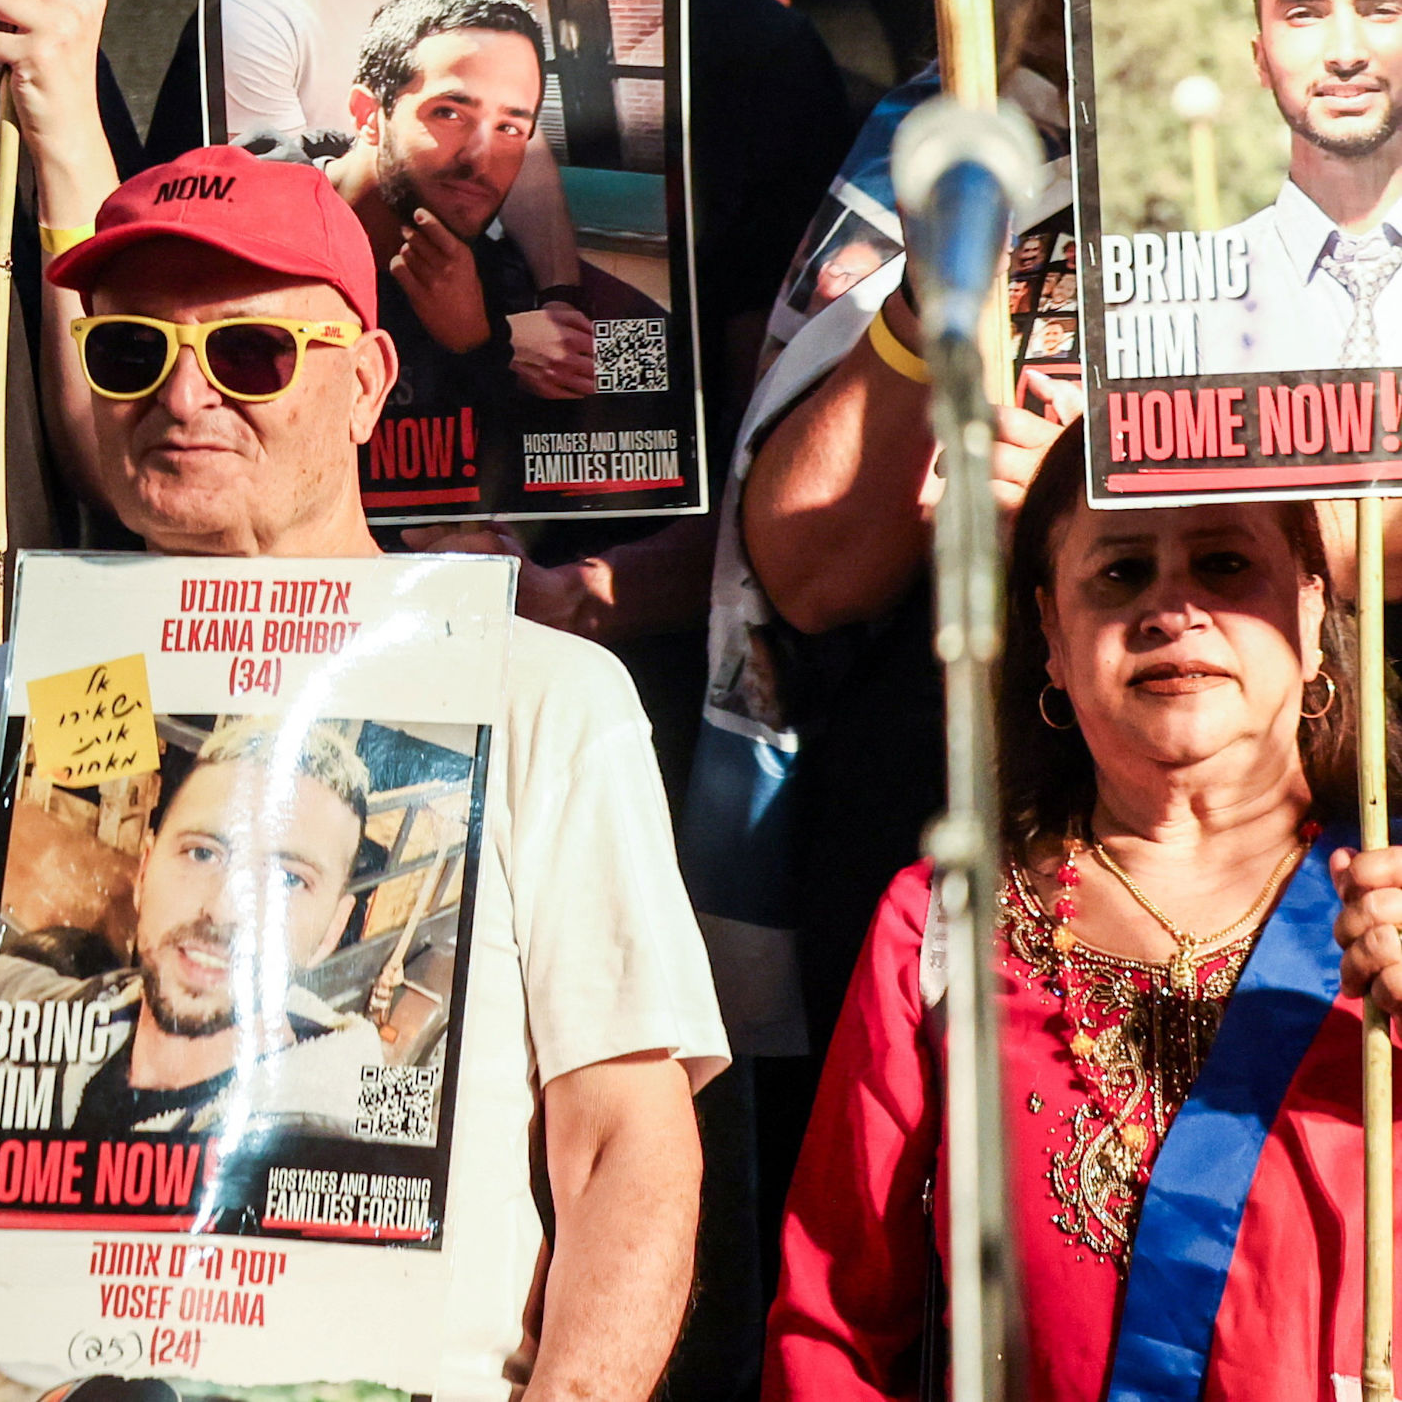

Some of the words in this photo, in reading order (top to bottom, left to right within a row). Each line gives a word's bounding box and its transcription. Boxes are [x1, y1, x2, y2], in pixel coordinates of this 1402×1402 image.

[1101, 230, 1249, 304] BRING
[1104, 308, 1200, 380] HIM
[1108, 387, 1246, 463] HOME
[1258, 371, 1402, 457] NOW!
[370, 406, 478, 480] NOW!
[523, 432, 587, 455] HOSTAGES
[589, 431, 617, 452] AND
[618, 429, 678, 451] MISSING
[524, 453, 608, 484] FAMILIES
[610, 450, 680, 482] FORUM
[180, 579, 263, 614] בוחבוט
[270, 580, 352, 618] אלקנה
[161, 619, 255, 653] ELKANA
[262, 619, 361, 655] BOHBOT
[228, 657, 283, 697] (34)
[268, 1167, 339, 1193] HOSTAGES
[339, 1170, 368, 1195] AND
[369, 1174, 432, 1201] MISSING
[265, 1190, 356, 1228] FAMILIES
[357, 1197, 430, 1233] FORUM
[89, 1241, 162, 1278] אוחנה
[230, 1248, 287, 1286] יוסף
[100, 1284, 173, 1320] YOSEF
[179, 1287, 265, 1327] OHANA
[150, 1326, 202, 1368] (24)
